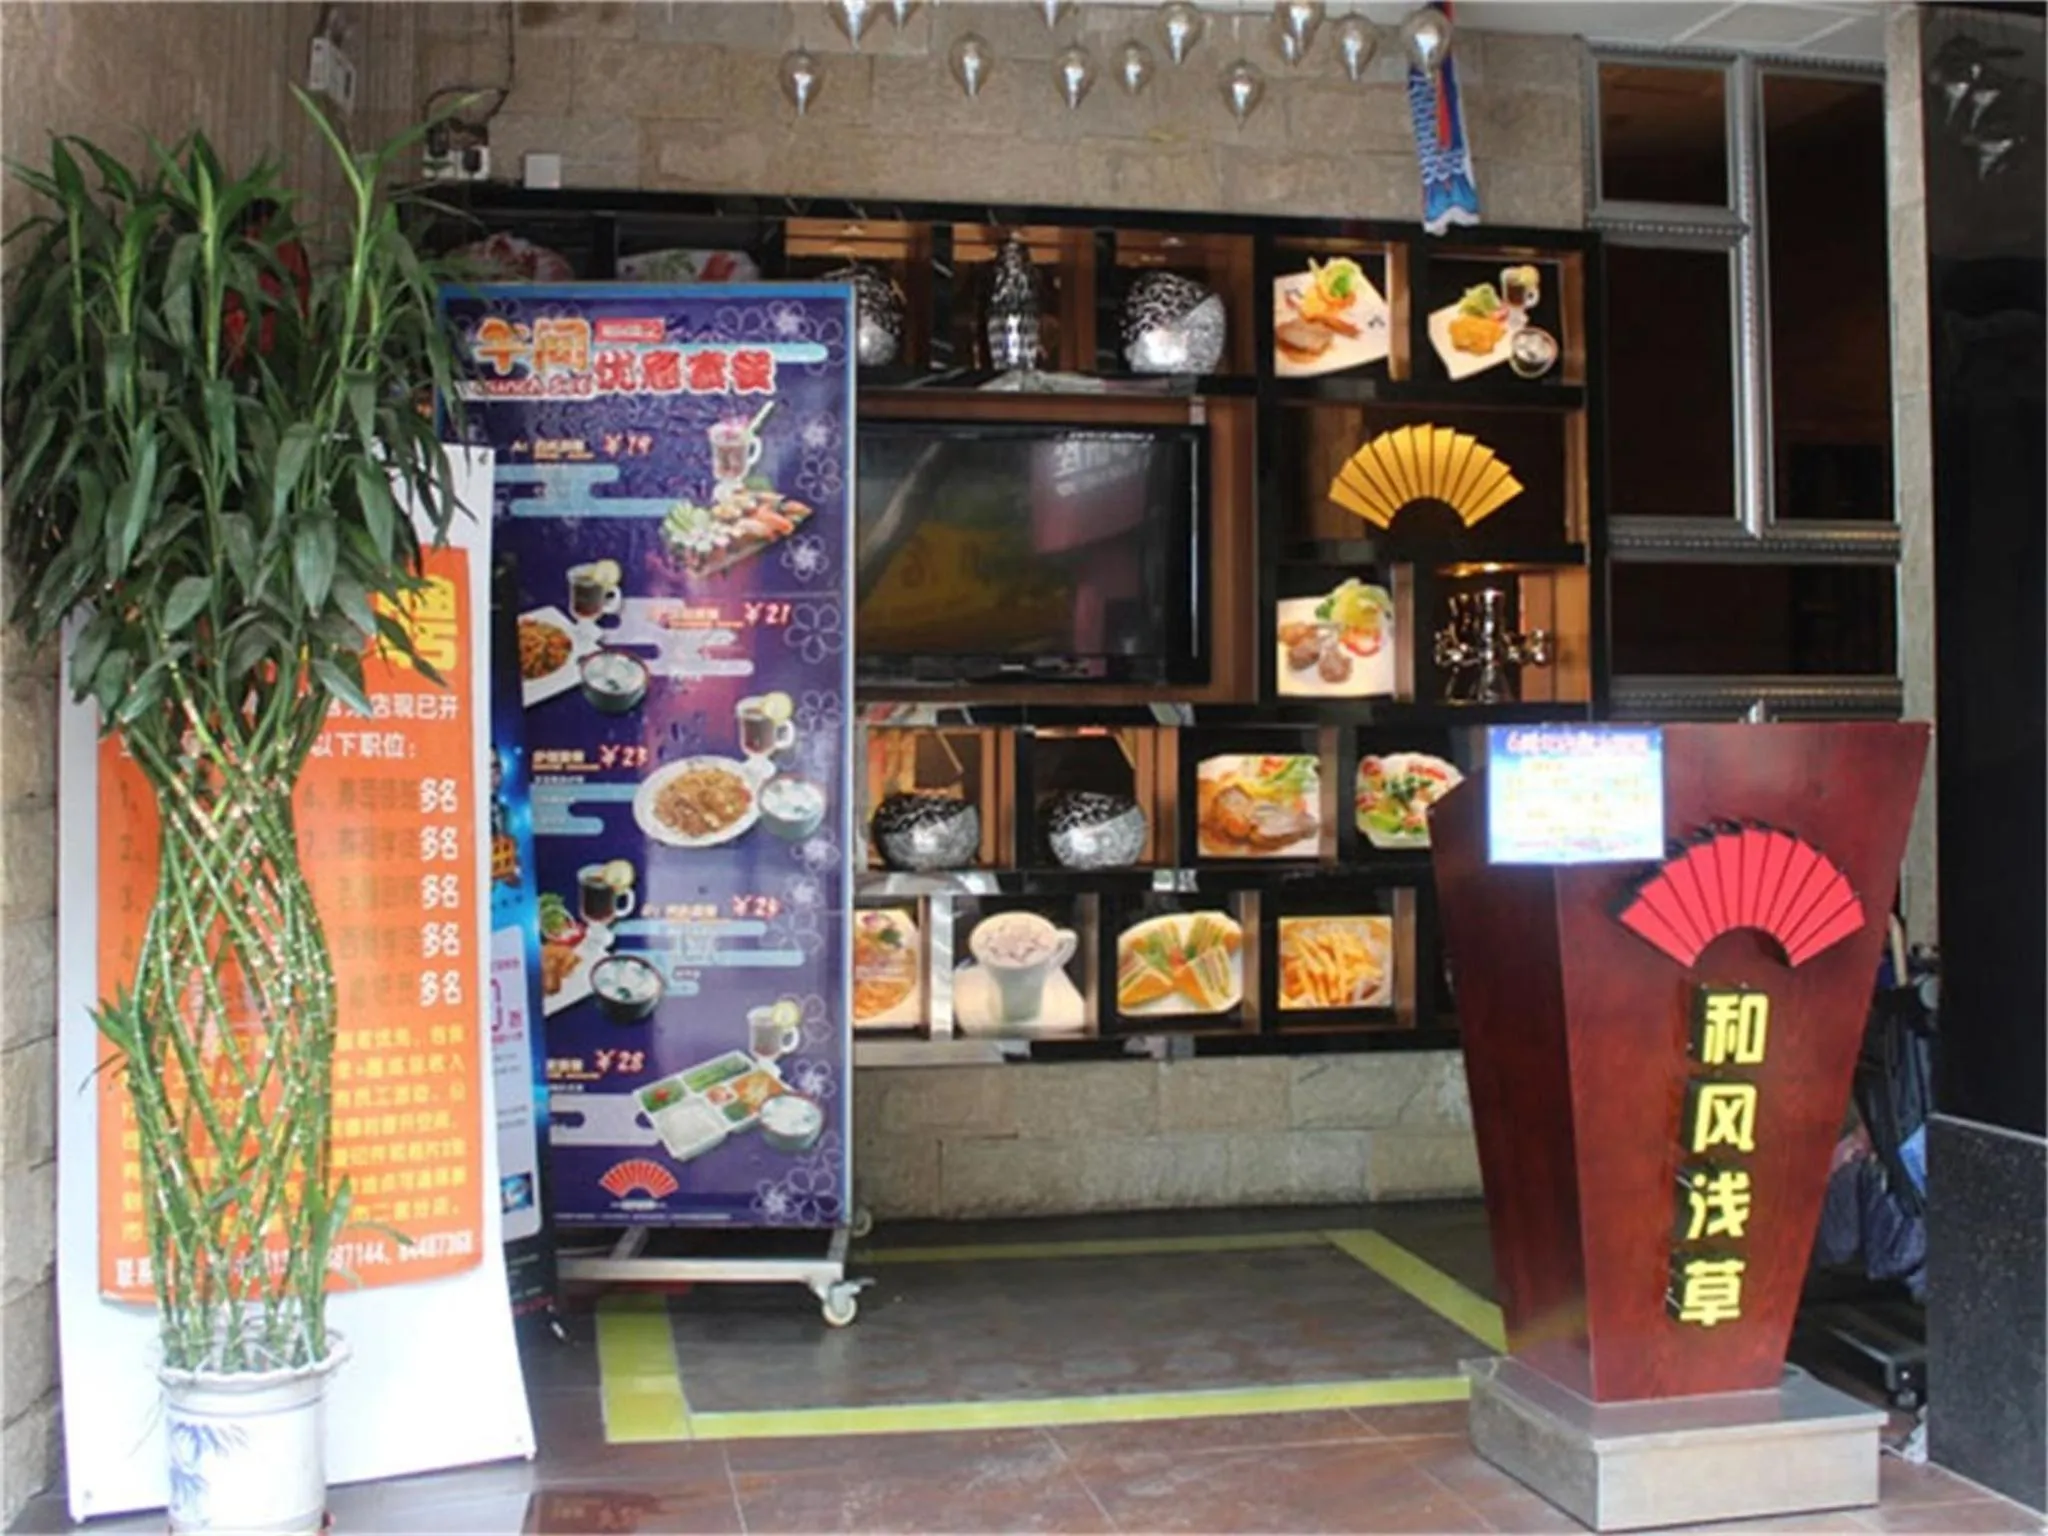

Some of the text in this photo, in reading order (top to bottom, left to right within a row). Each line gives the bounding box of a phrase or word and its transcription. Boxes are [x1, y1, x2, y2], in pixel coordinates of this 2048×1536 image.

[420, 778, 458, 813] 多名
[420, 826, 458, 862] 多名
[421, 874, 459, 909] 多名
[421, 922, 460, 958] 多名
[420, 970, 461, 1006] 多名
[1680, 994, 1769, 1326] 和风浅草
